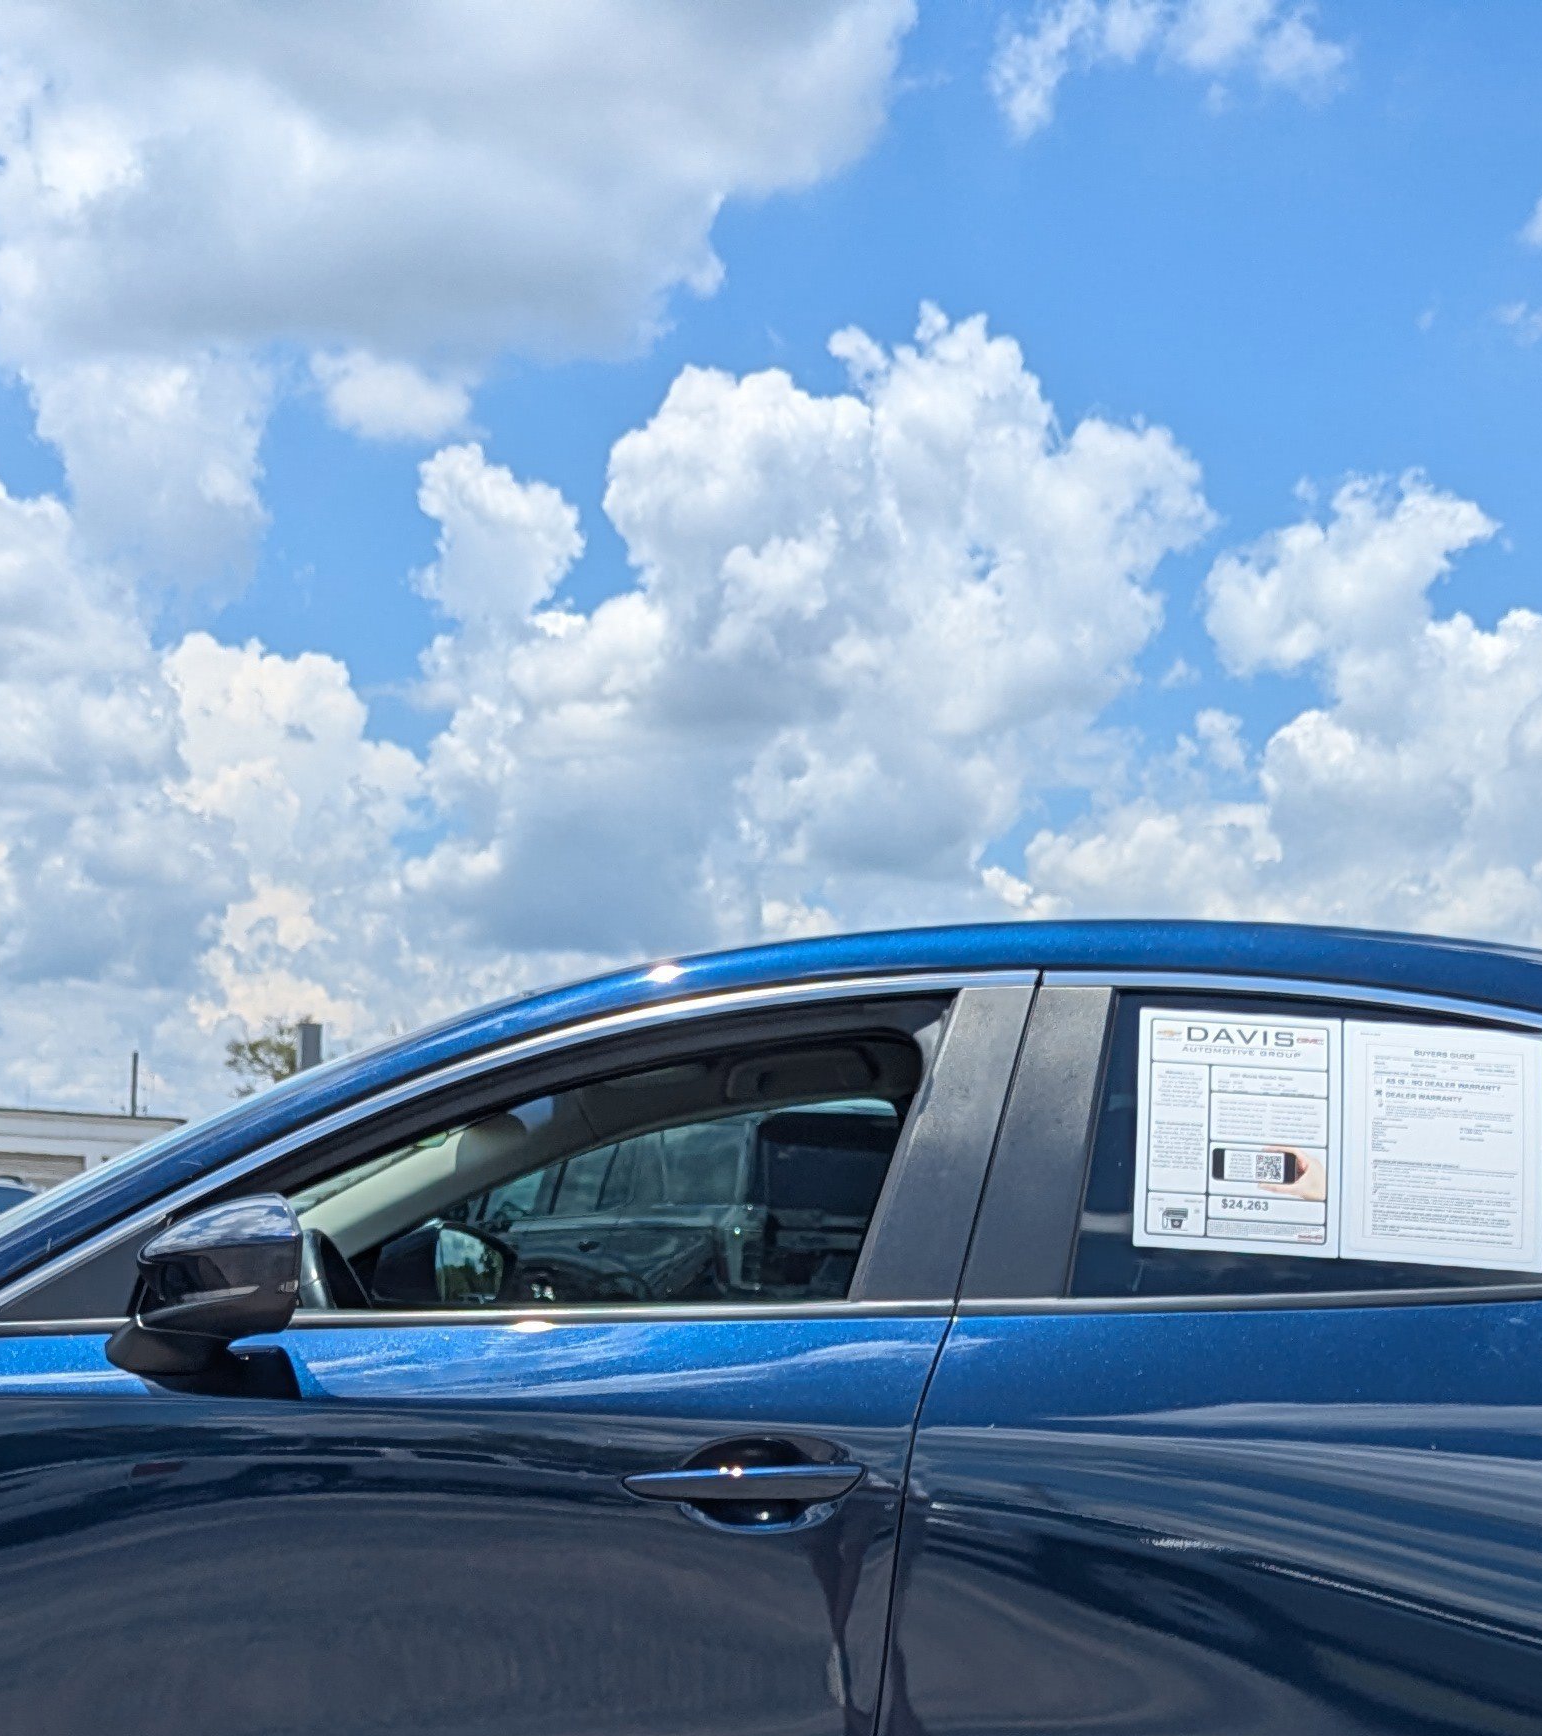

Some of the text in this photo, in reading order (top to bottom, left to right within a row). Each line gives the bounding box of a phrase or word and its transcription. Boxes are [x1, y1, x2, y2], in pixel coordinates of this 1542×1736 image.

[1186, 1026, 1295, 1048] DAVIS
[1181, 1046, 1302, 1059] AUTOMOTIVE GROUP
[1413, 1050, 1448, 1060] BUYERS
[1221, 1199, 1270, 1212] $24,263
